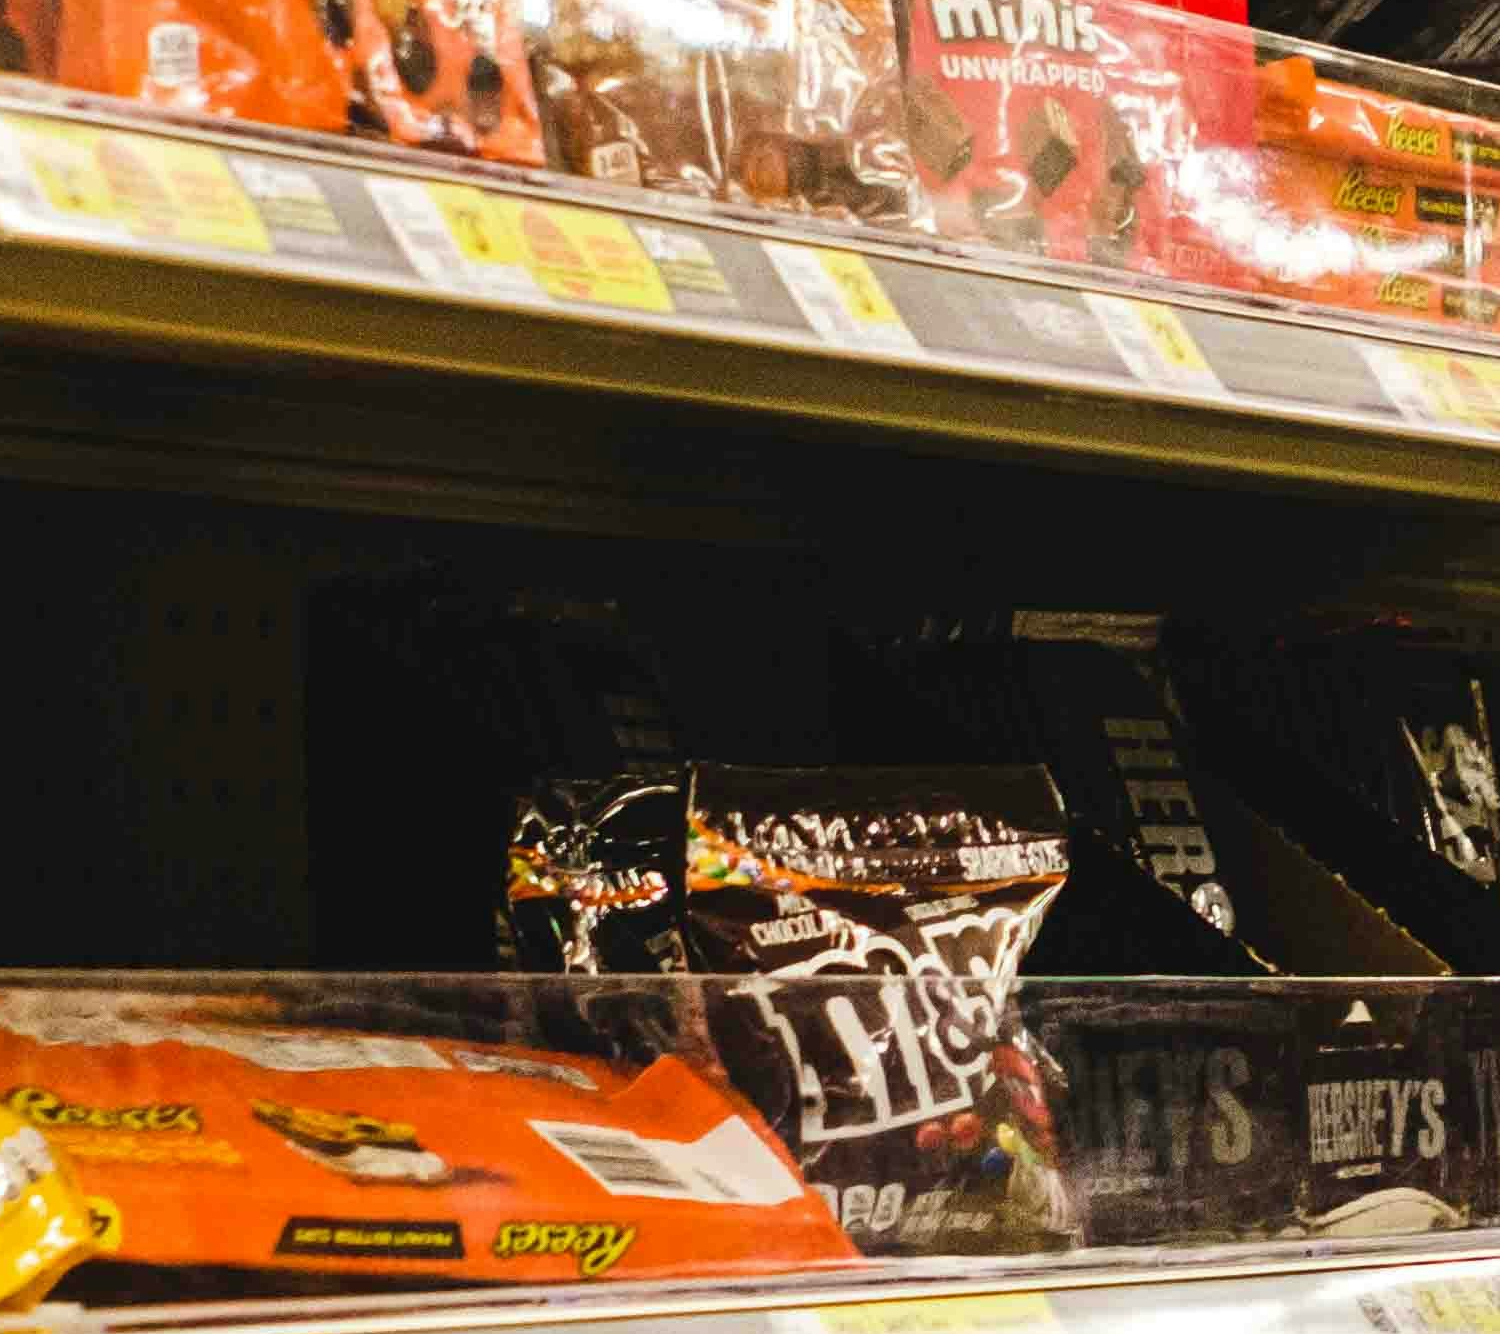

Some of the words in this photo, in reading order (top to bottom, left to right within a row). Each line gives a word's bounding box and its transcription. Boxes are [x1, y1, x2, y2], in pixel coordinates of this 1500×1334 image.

[940, 52, 1107, 97] UNWRAPPED
[750, 910, 862, 949] CHOCOLA
[1308, 1079, 1446, 1164] HERSHEY'S
